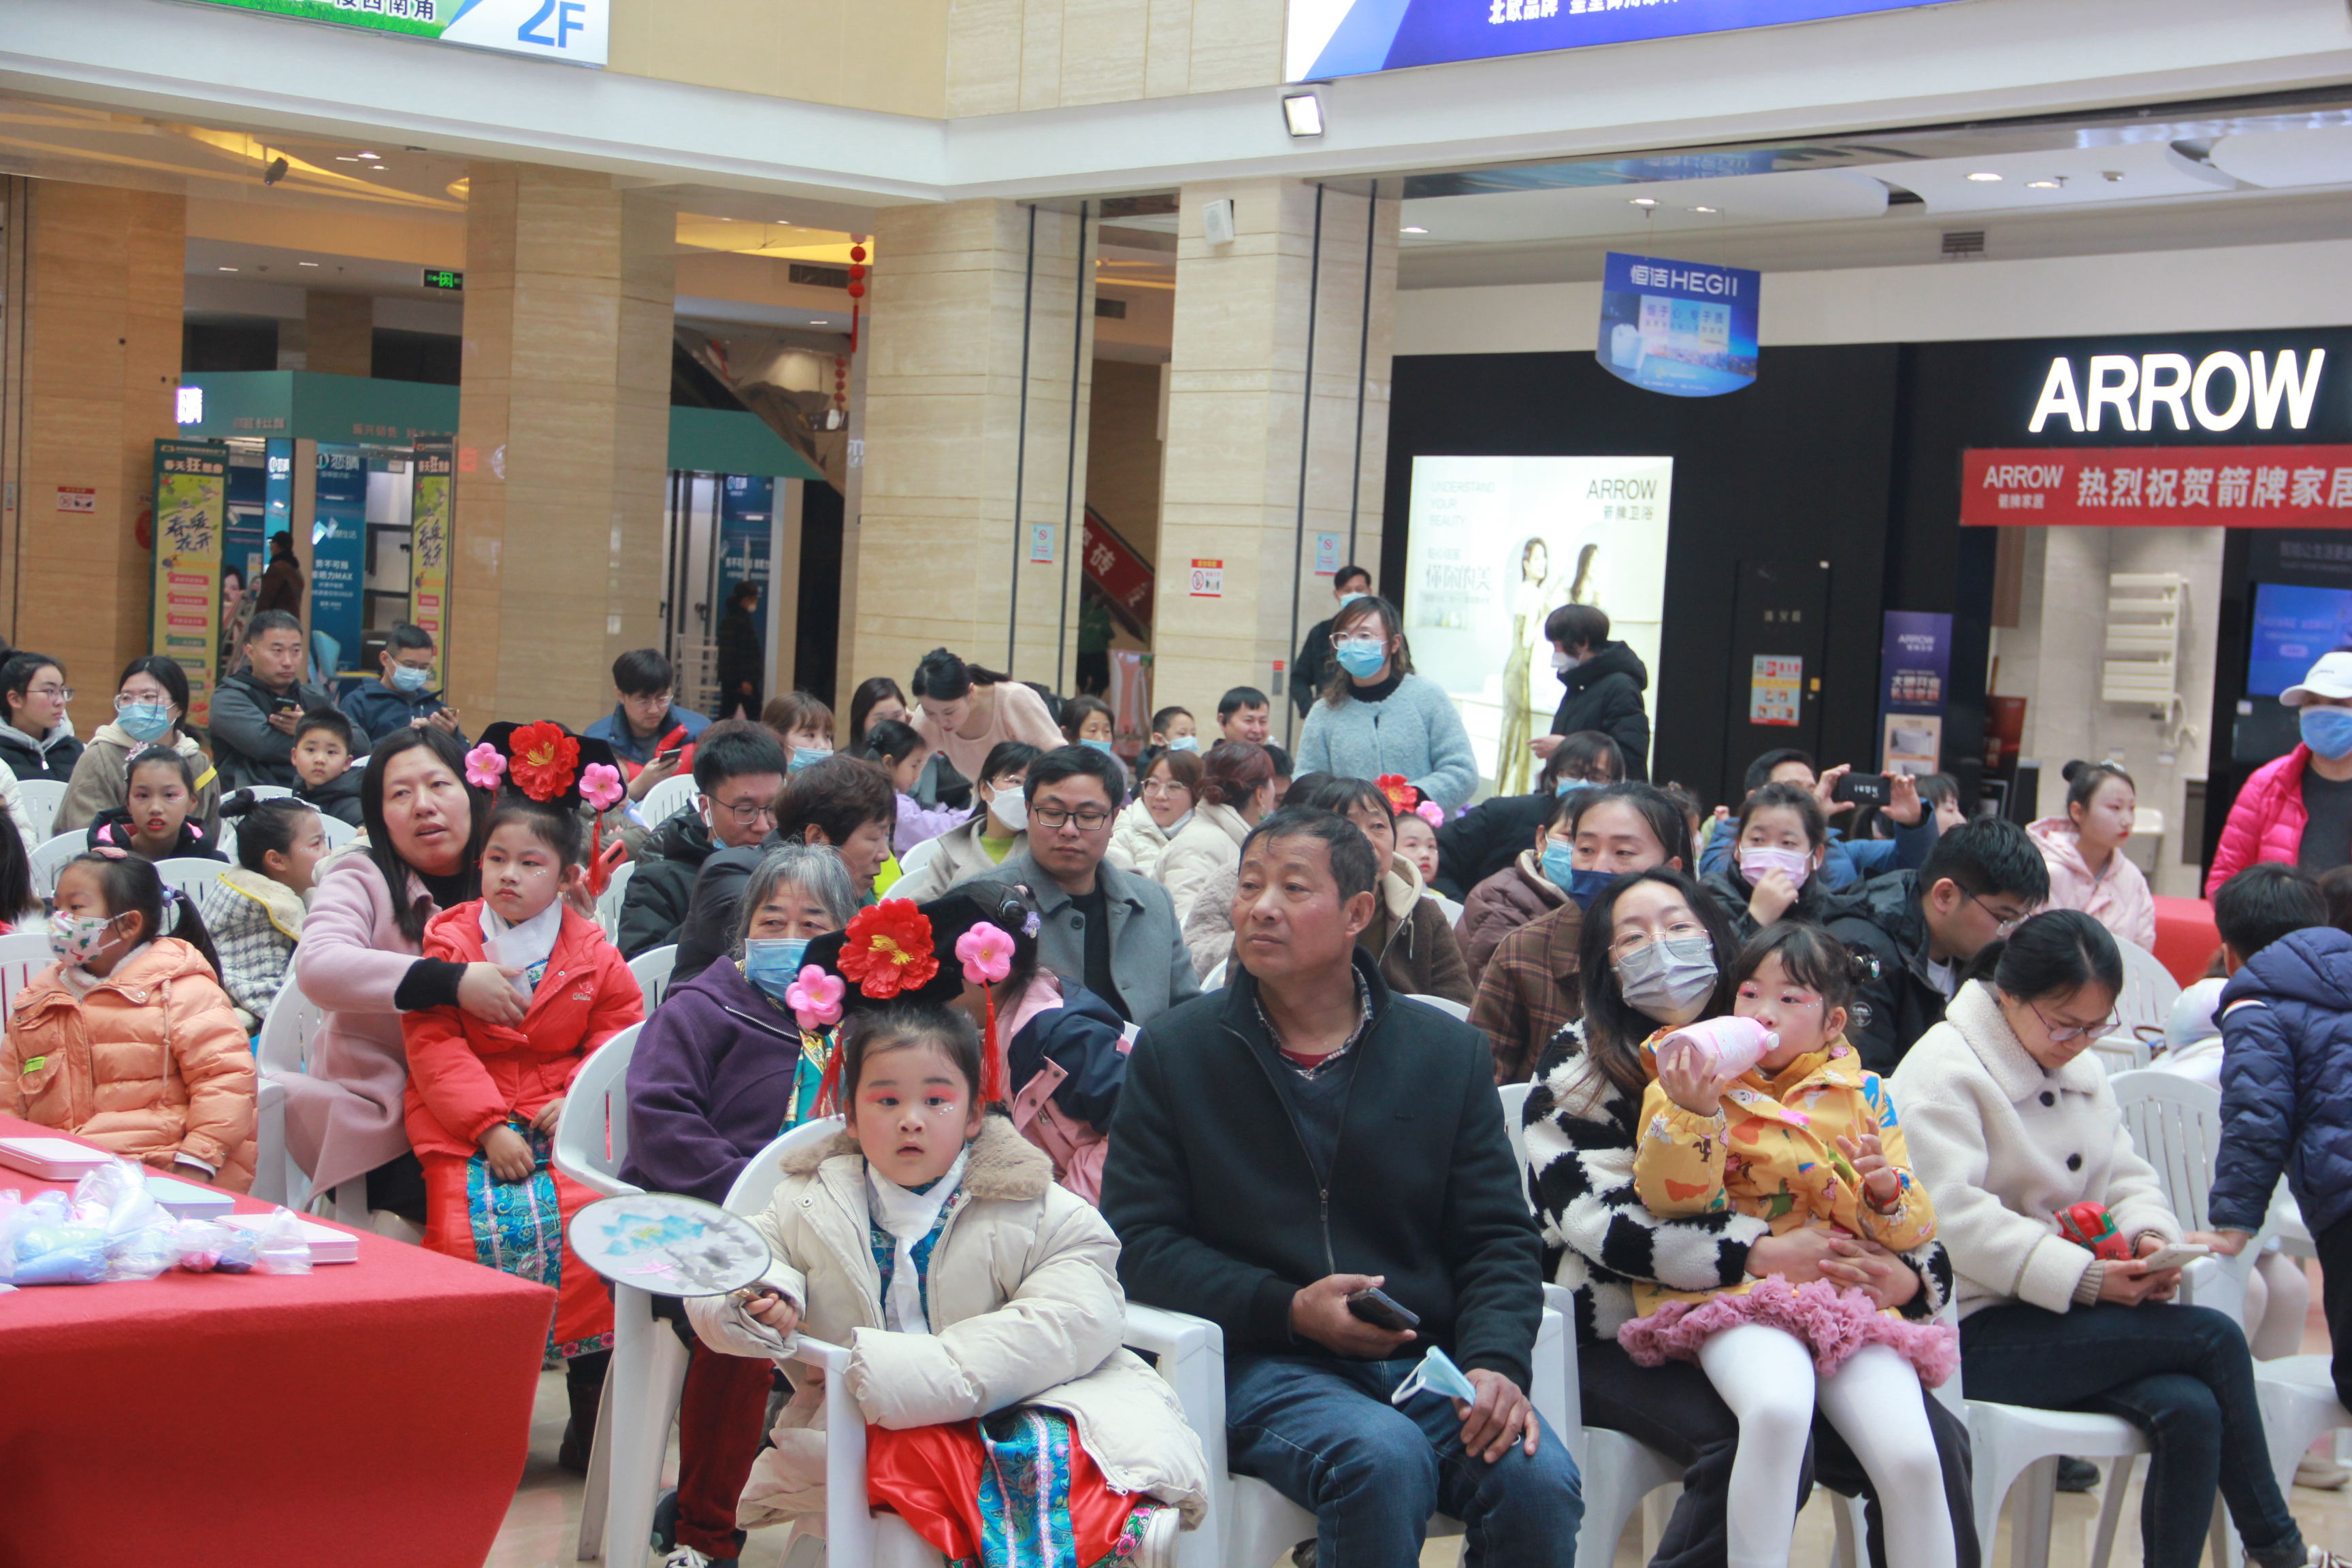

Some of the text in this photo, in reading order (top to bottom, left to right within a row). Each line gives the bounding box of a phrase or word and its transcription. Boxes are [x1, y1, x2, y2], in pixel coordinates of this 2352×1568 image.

[518, 0, 586, 48] 2F
[2028, 348, 2325, 433] ARROW
[1431, 480, 1496, 493] UNDERSTAND
[1983, 465, 2064, 489] ARROW
[2076, 466, 2352, 508] 热烈祝贺箭牌家居
[1586, 478, 1657, 500] ARROW
[1430, 498, 1458, 510] YOUR
[1429, 514, 1467, 527] BEAUTY
